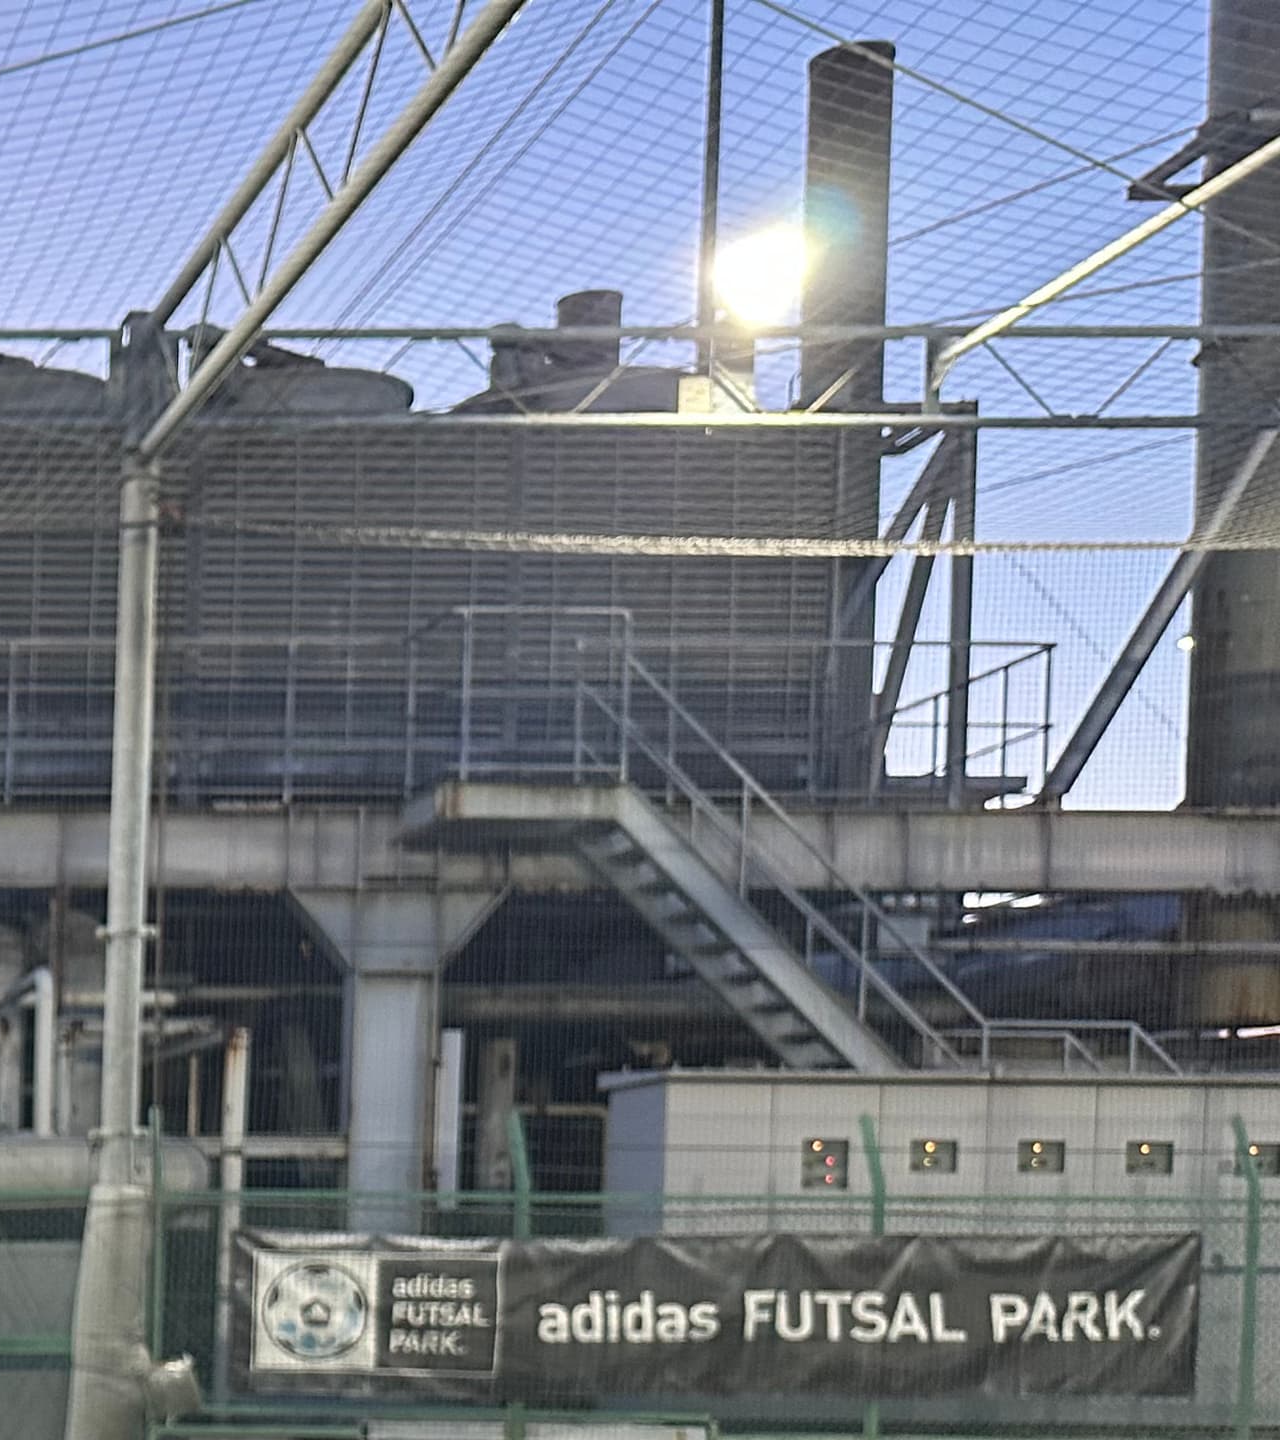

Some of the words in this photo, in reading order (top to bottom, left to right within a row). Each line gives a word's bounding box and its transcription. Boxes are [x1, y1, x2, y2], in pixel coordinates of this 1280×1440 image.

[392, 1273, 477, 1299] adidas
[392, 1301, 491, 1327] FUTSAL
[538, 1290, 721, 1344] adidas
[743, 1289, 966, 1343] FUTSAL
